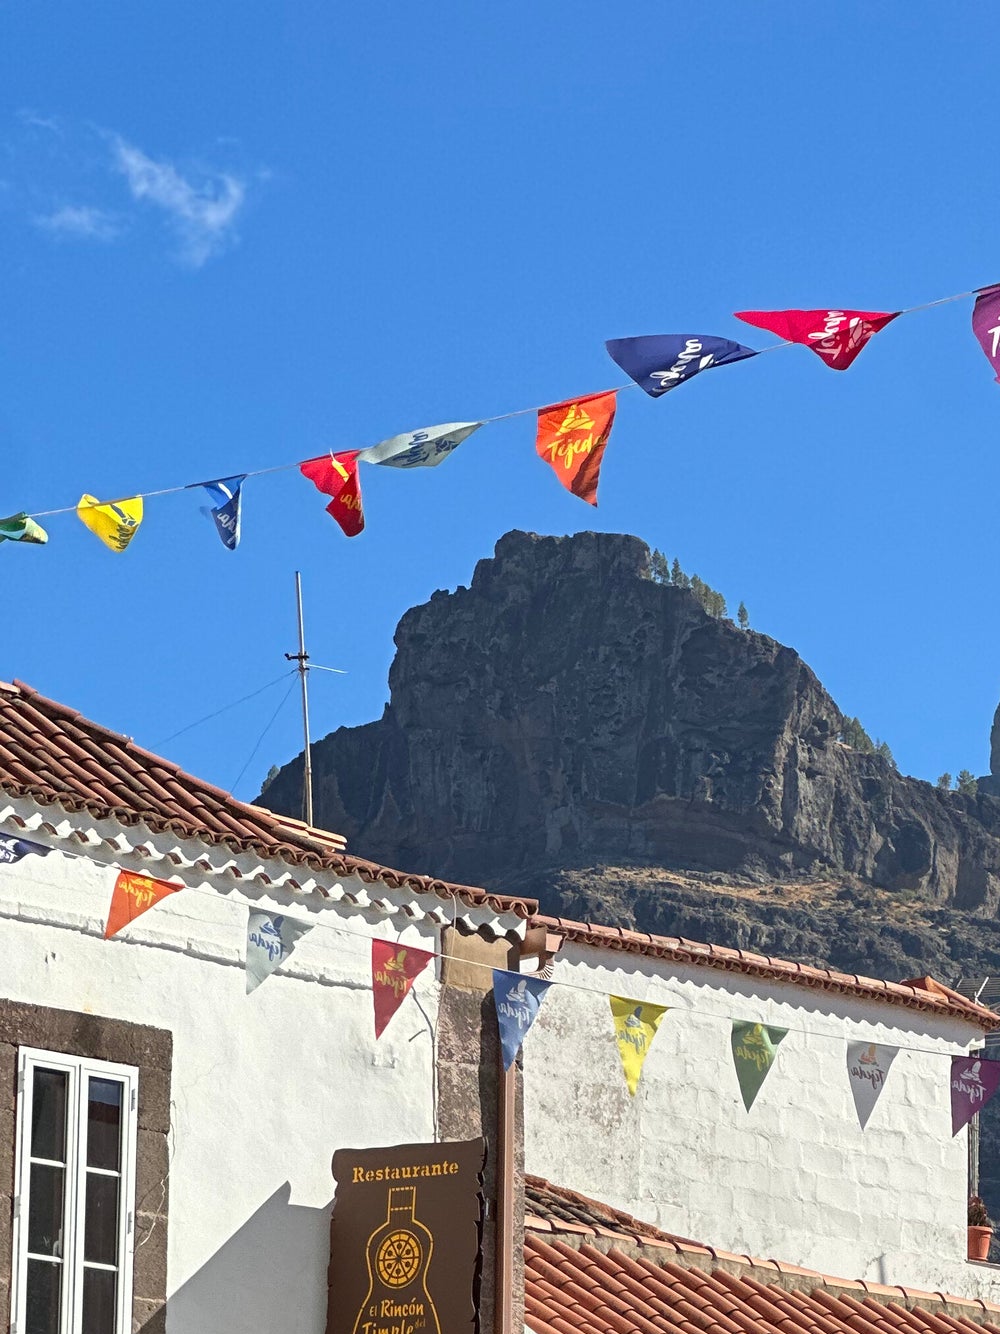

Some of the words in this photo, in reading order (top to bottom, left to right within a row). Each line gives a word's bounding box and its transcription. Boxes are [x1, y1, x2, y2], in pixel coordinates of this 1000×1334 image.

[352, 1160, 459, 1183] Restaurante
[370, 1305, 378, 1317] El
[381, 1297, 424, 1317] Rincón
[415, 1318, 426, 1328] del
